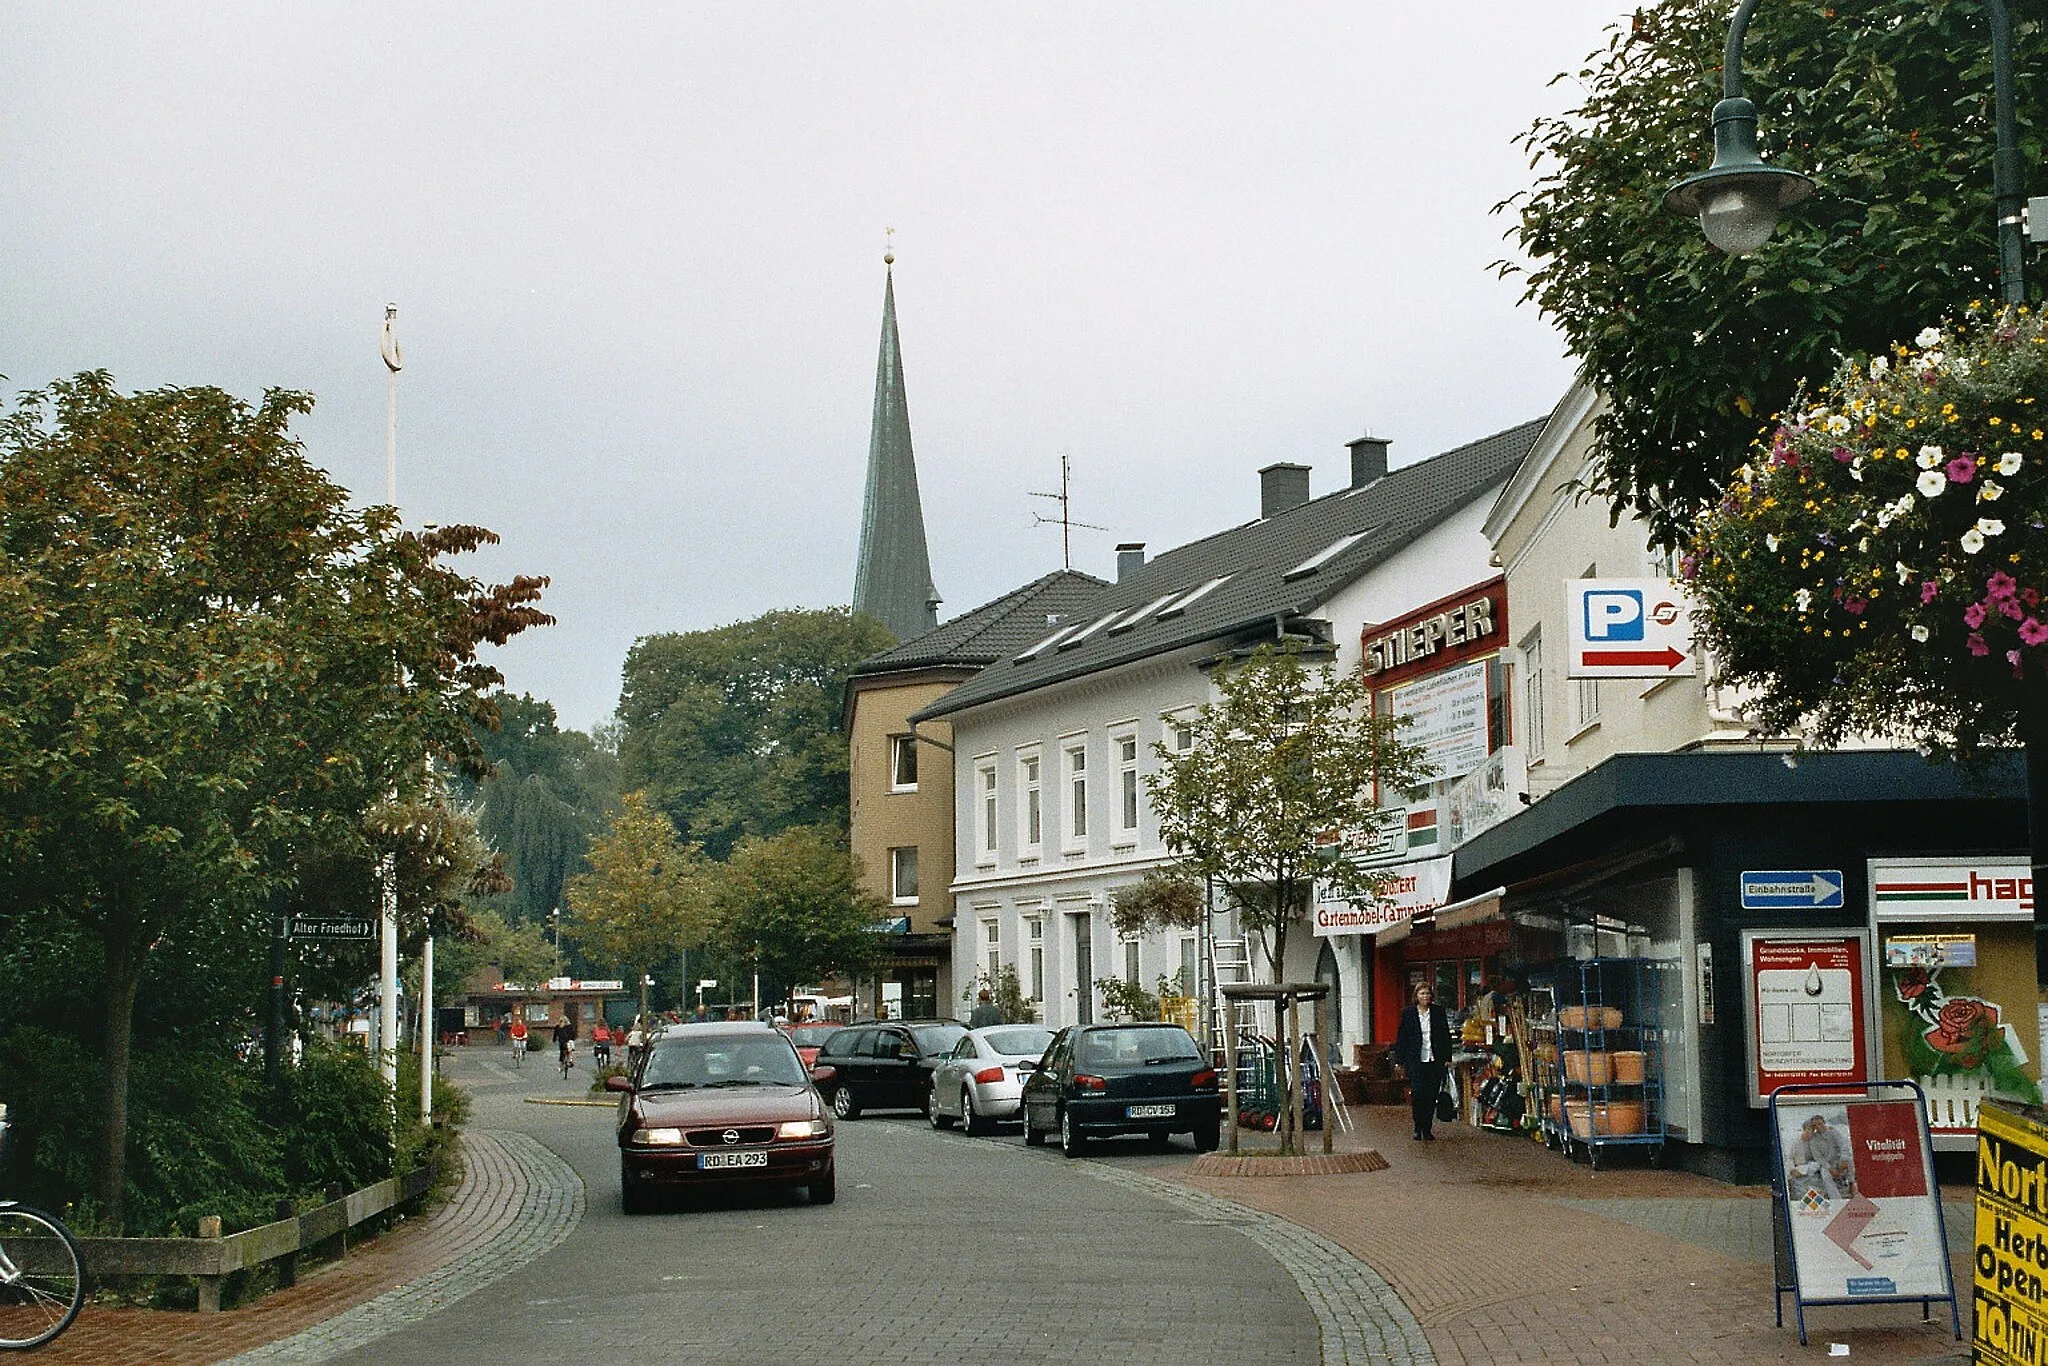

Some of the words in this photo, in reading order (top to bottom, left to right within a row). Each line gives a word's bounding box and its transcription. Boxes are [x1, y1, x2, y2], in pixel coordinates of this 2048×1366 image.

[1588, 594, 1641, 637] P
[1364, 597, 1493, 677] STIEPER
[1748, 885, 1816, 894] Einbahnstraße
[293, 922, 318, 934] Alter
[320, 922, 361, 935] Friedhof
[1132, 1105, 1142, 1115] RD
[1866, 1138, 1905, 1150] Vitalität
[705, 1156, 720, 1167] RD
[727, 1154, 742, 1167] EA
[745, 1153, 766, 1166] 293
